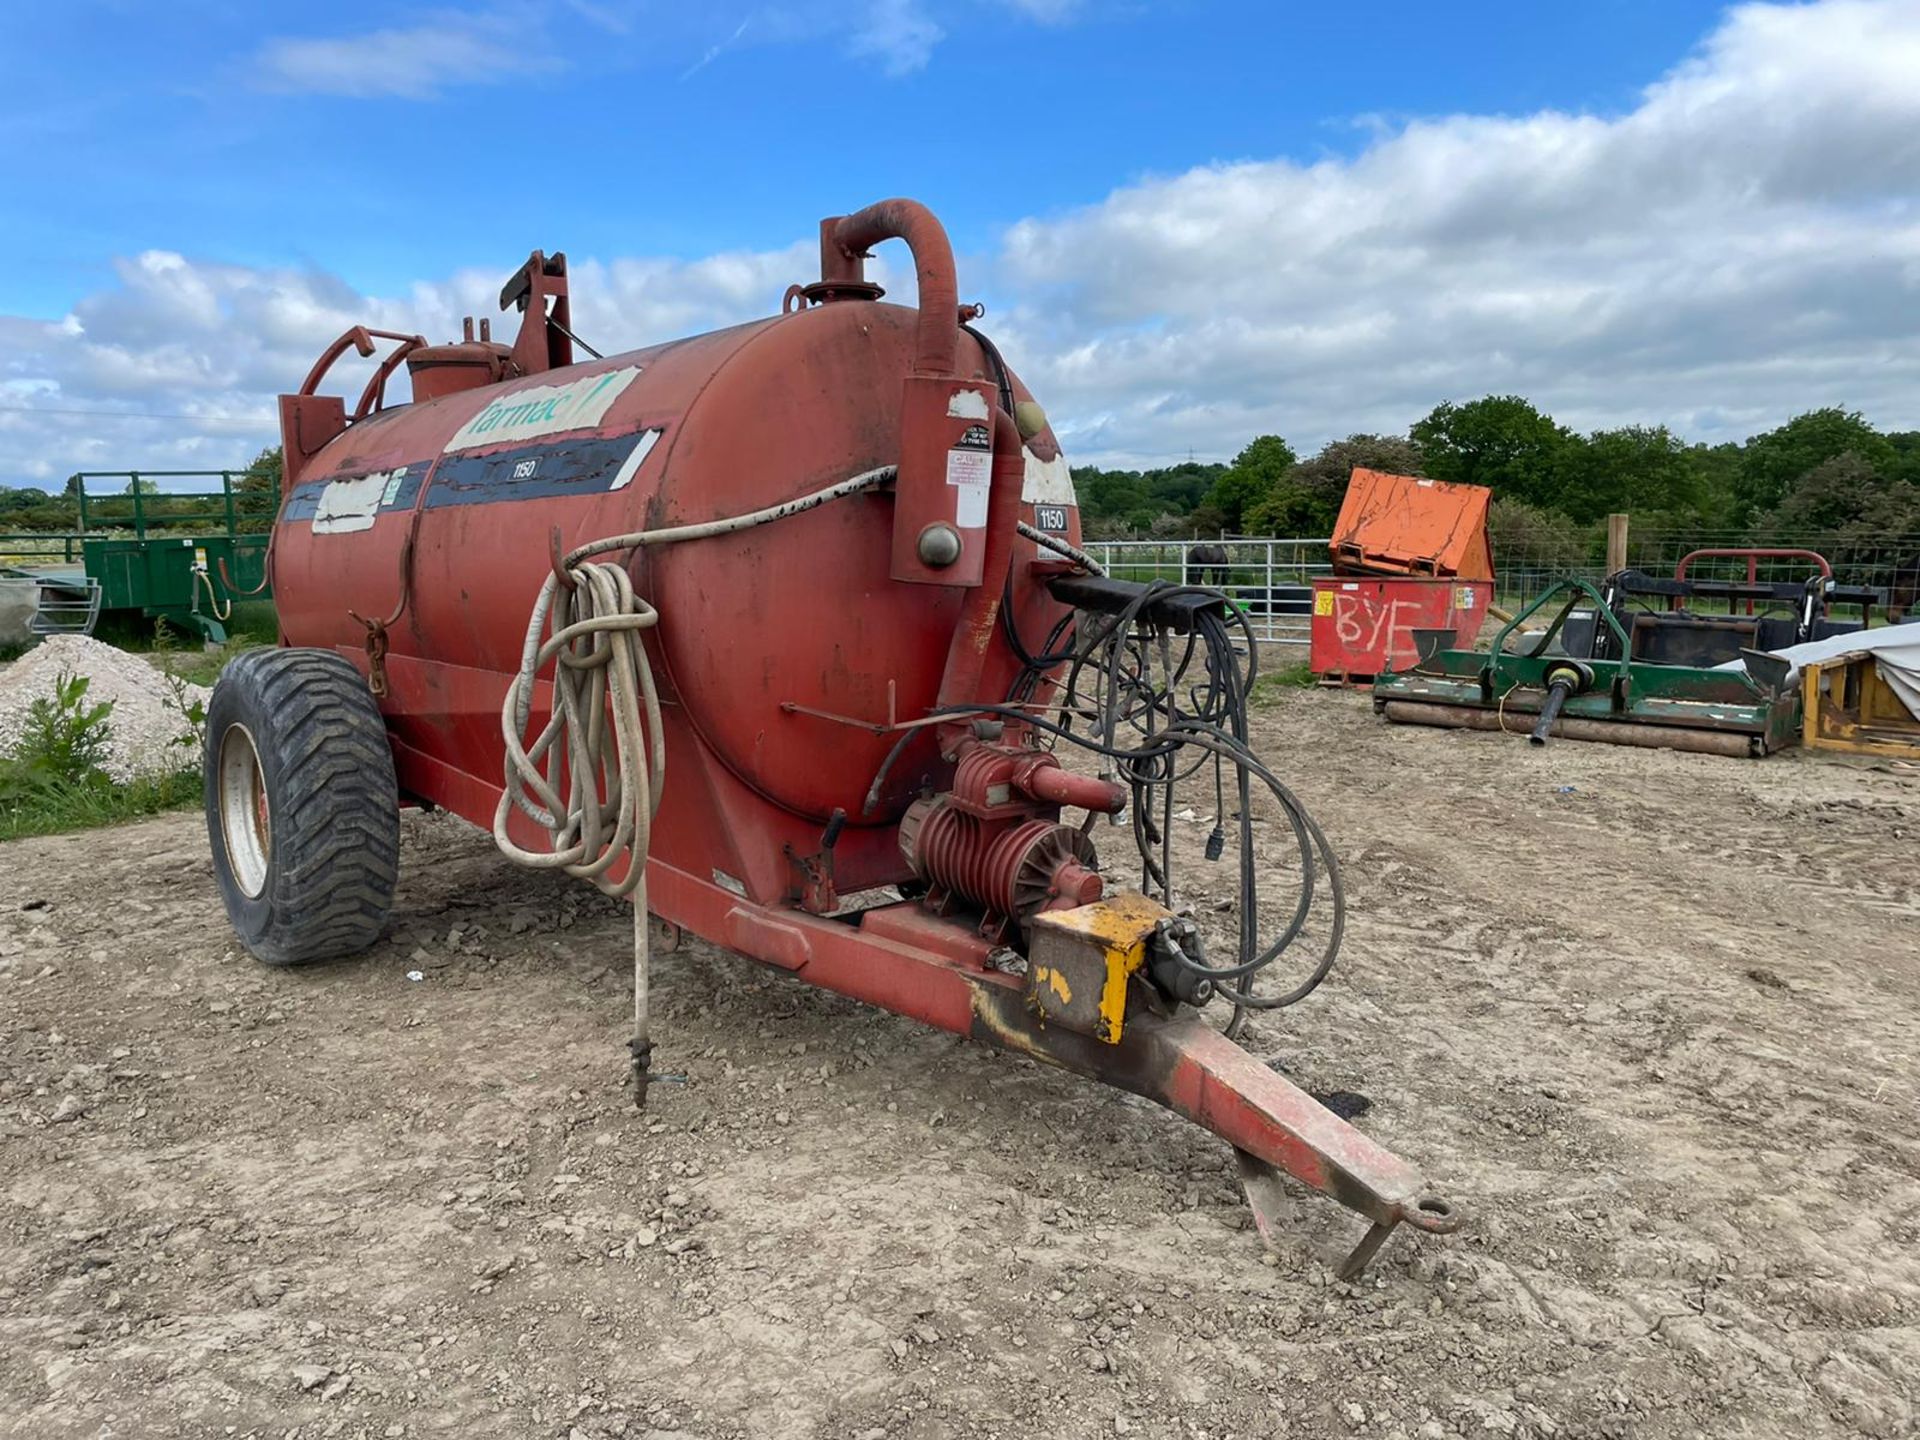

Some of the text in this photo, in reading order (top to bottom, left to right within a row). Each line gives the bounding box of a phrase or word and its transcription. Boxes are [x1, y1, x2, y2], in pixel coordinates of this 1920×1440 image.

[513, 460, 536, 479] 1150
[1040, 509, 1064, 529] 1150
[1334, 593, 1422, 656] BYE
